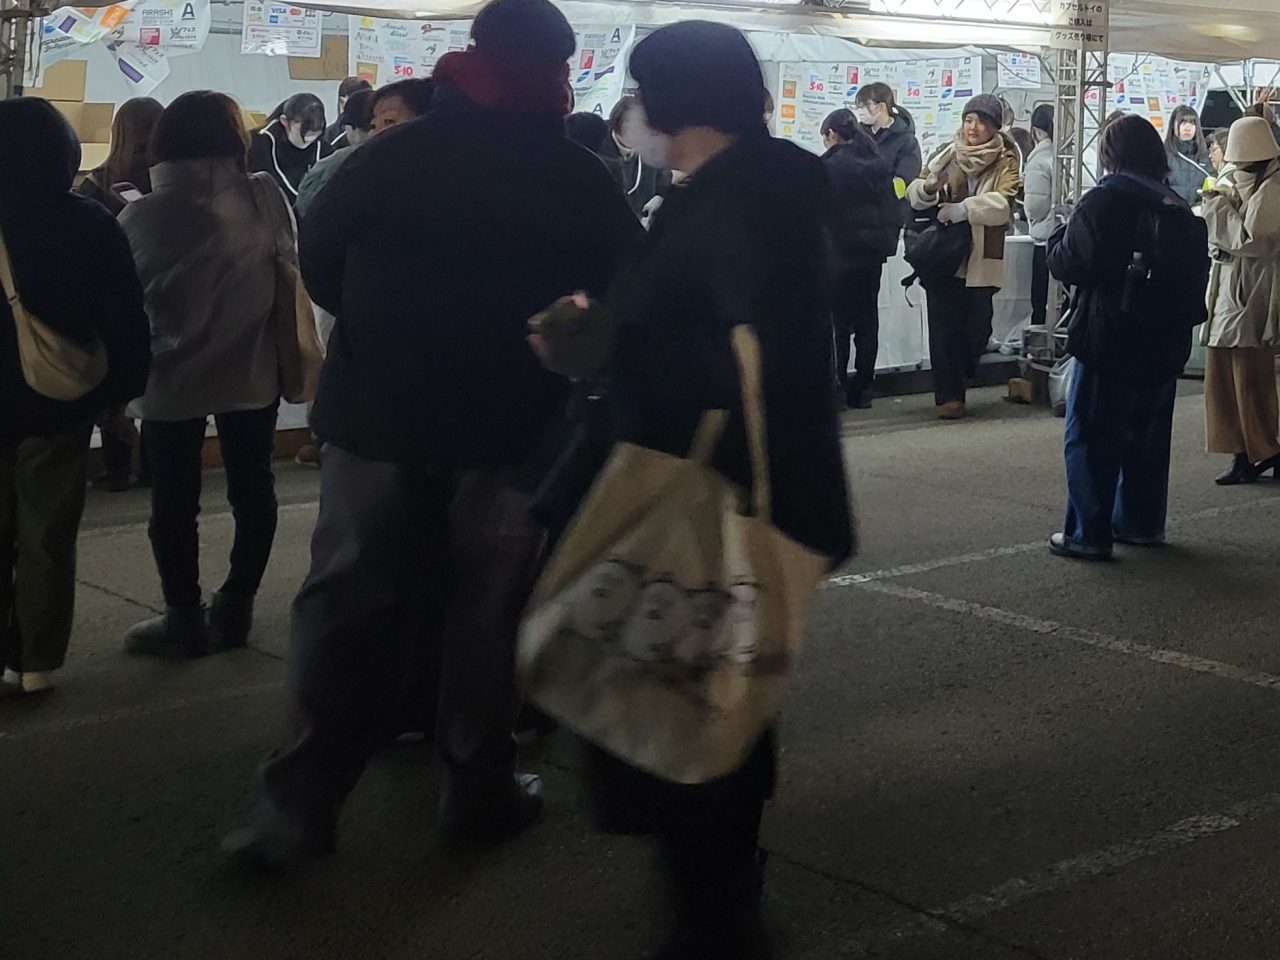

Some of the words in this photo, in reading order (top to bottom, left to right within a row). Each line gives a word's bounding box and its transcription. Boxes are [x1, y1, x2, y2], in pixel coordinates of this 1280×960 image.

[142, 8, 173, 16] ARASHI
[1060, 2, 1103, 13] カプセルトイの
[1069, 17, 1093, 27] ご購入は
[1056, 31, 1104, 43] グッズ売り場にて
